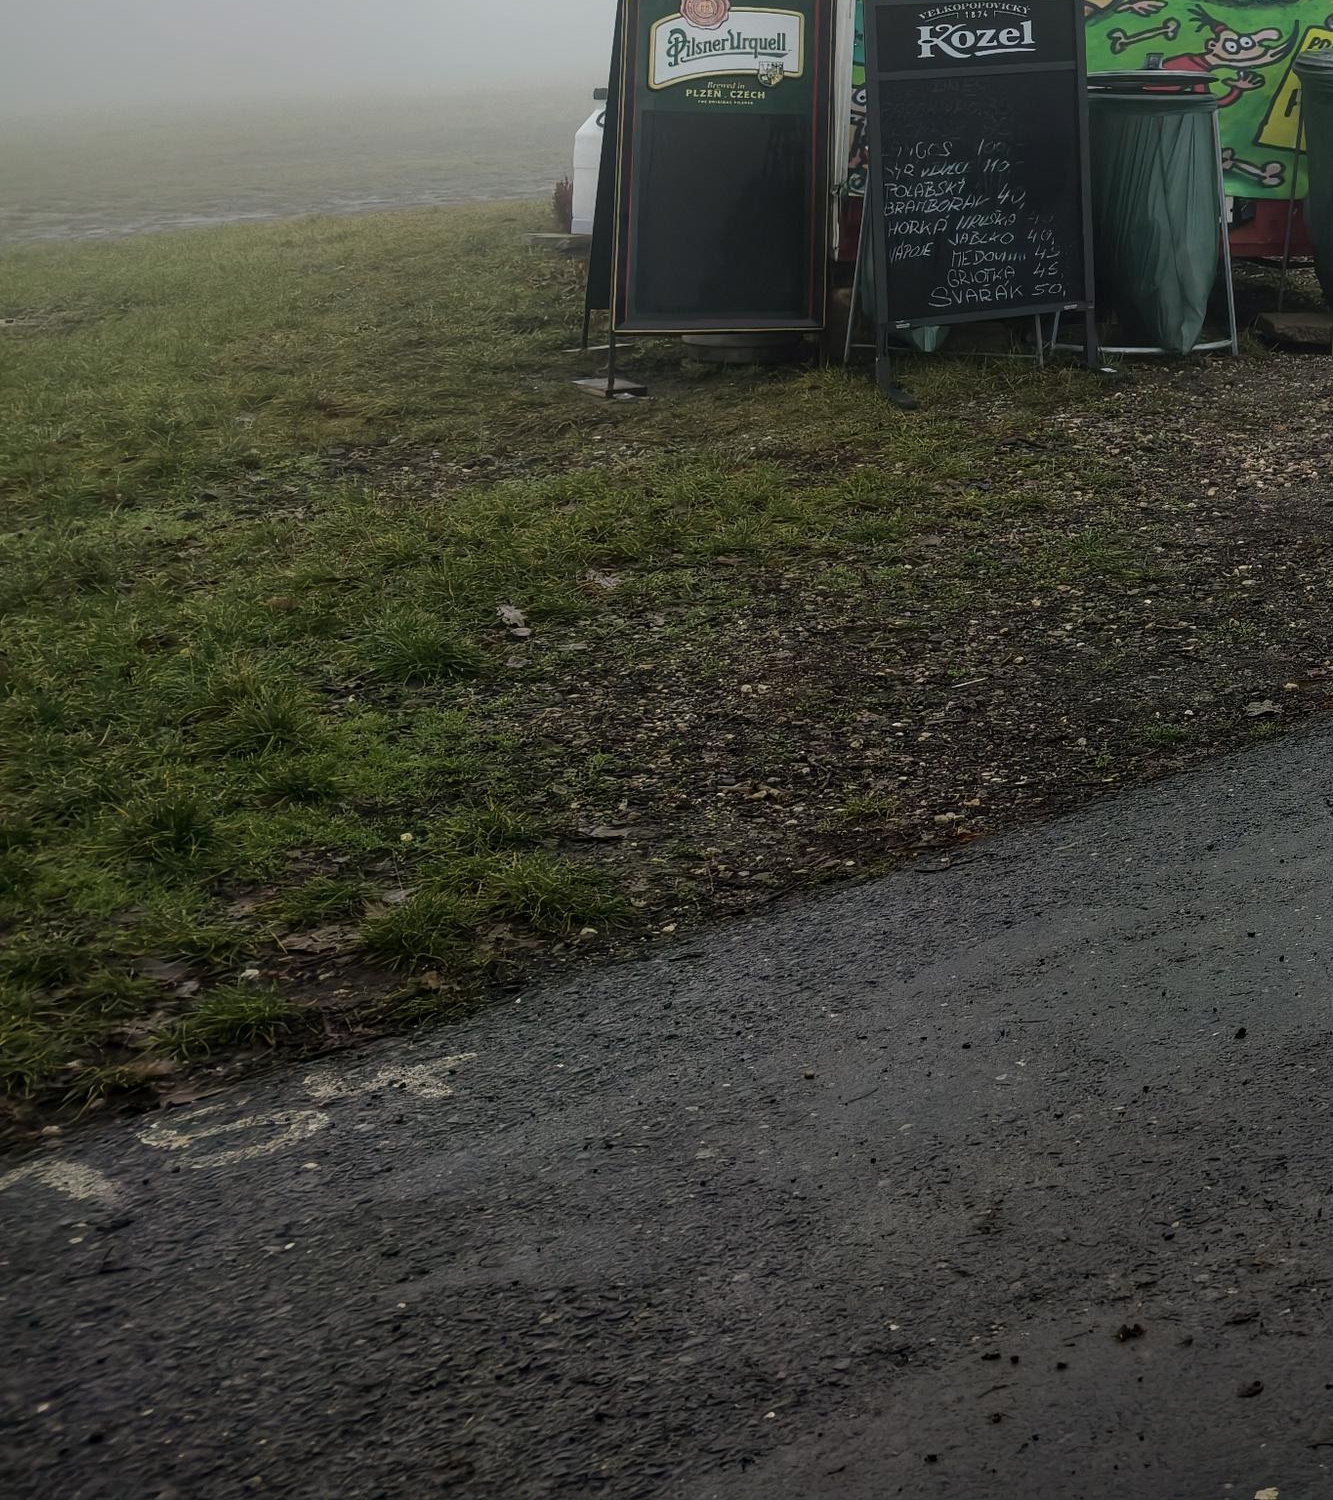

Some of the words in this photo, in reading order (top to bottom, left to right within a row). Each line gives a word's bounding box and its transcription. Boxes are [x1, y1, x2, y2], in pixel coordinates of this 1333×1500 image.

[919, 2, 1031, 19] VELKOPOPOVICKÝ
[666, 28, 728, 67] Pilsner
[728, 29, 786, 58] Urquell
[916, 20, 1036, 58] Kozel
[730, 90, 766, 99] CZECH
